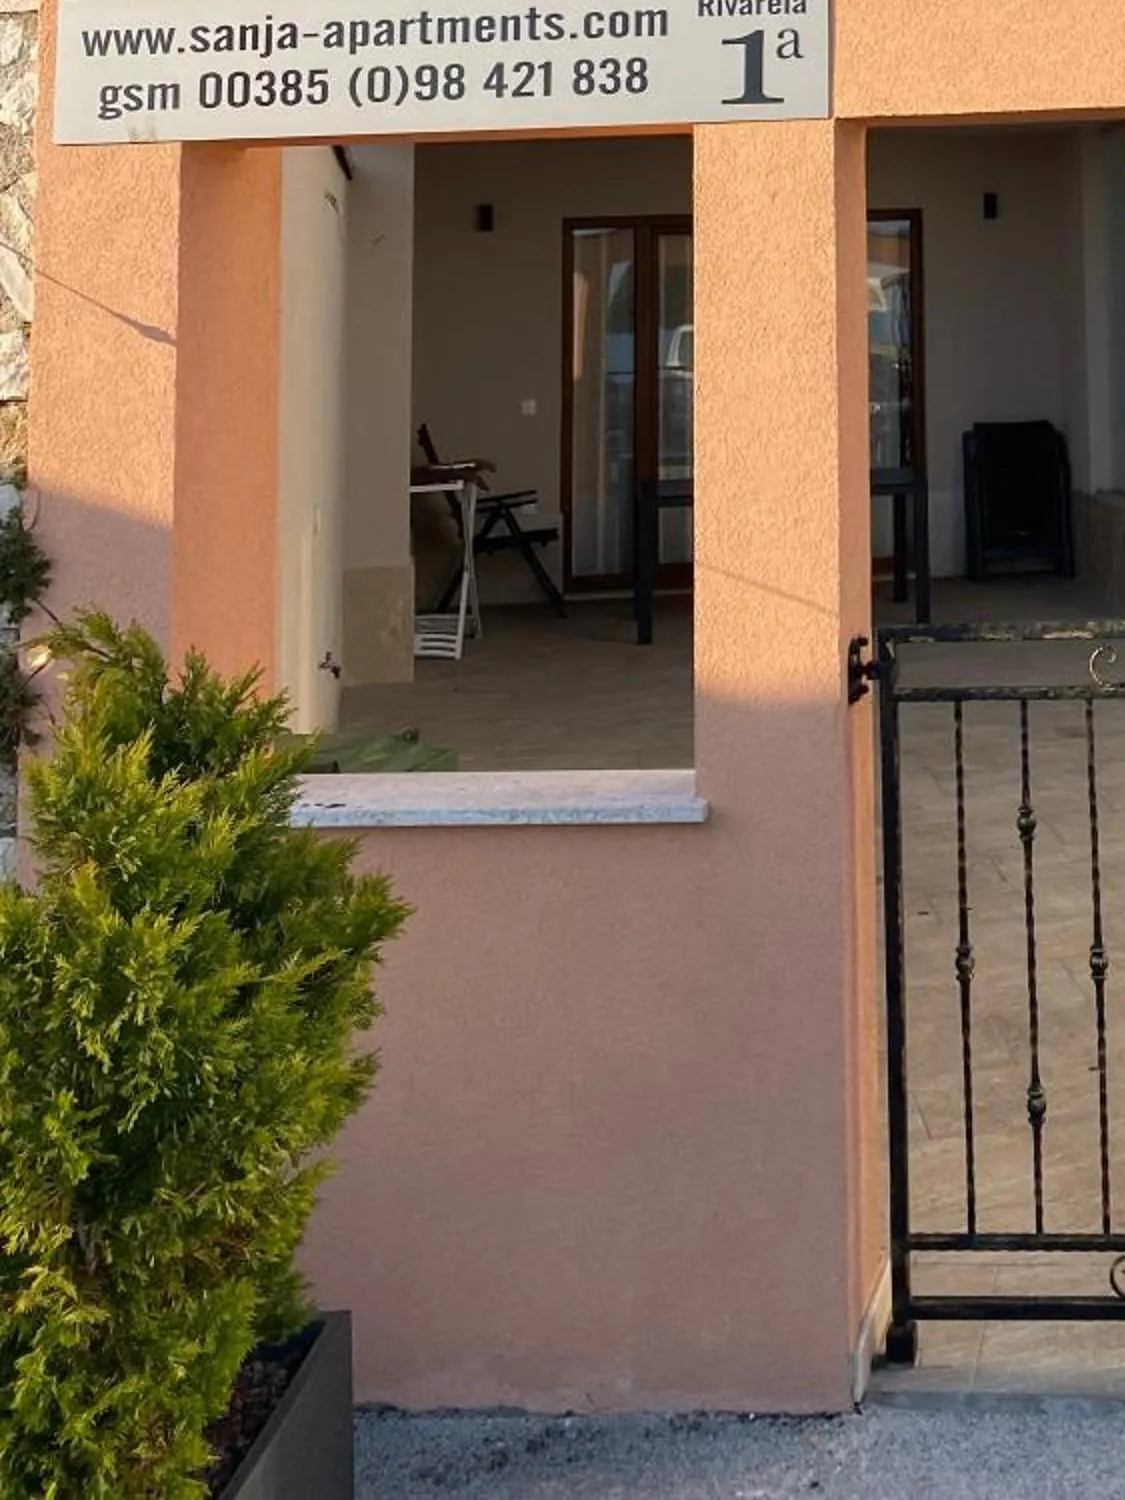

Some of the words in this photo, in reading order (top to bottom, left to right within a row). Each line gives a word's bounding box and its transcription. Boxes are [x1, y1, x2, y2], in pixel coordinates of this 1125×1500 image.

[81, 8, 668, 59] www.sanja-apartments.com
[98, 83, 181, 120] gsm
[199, 68, 329, 109] 00385
[349, 63, 465, 107] (0)98
[483, 61, 552, 98] 421
[572, 57, 649, 96] 838
